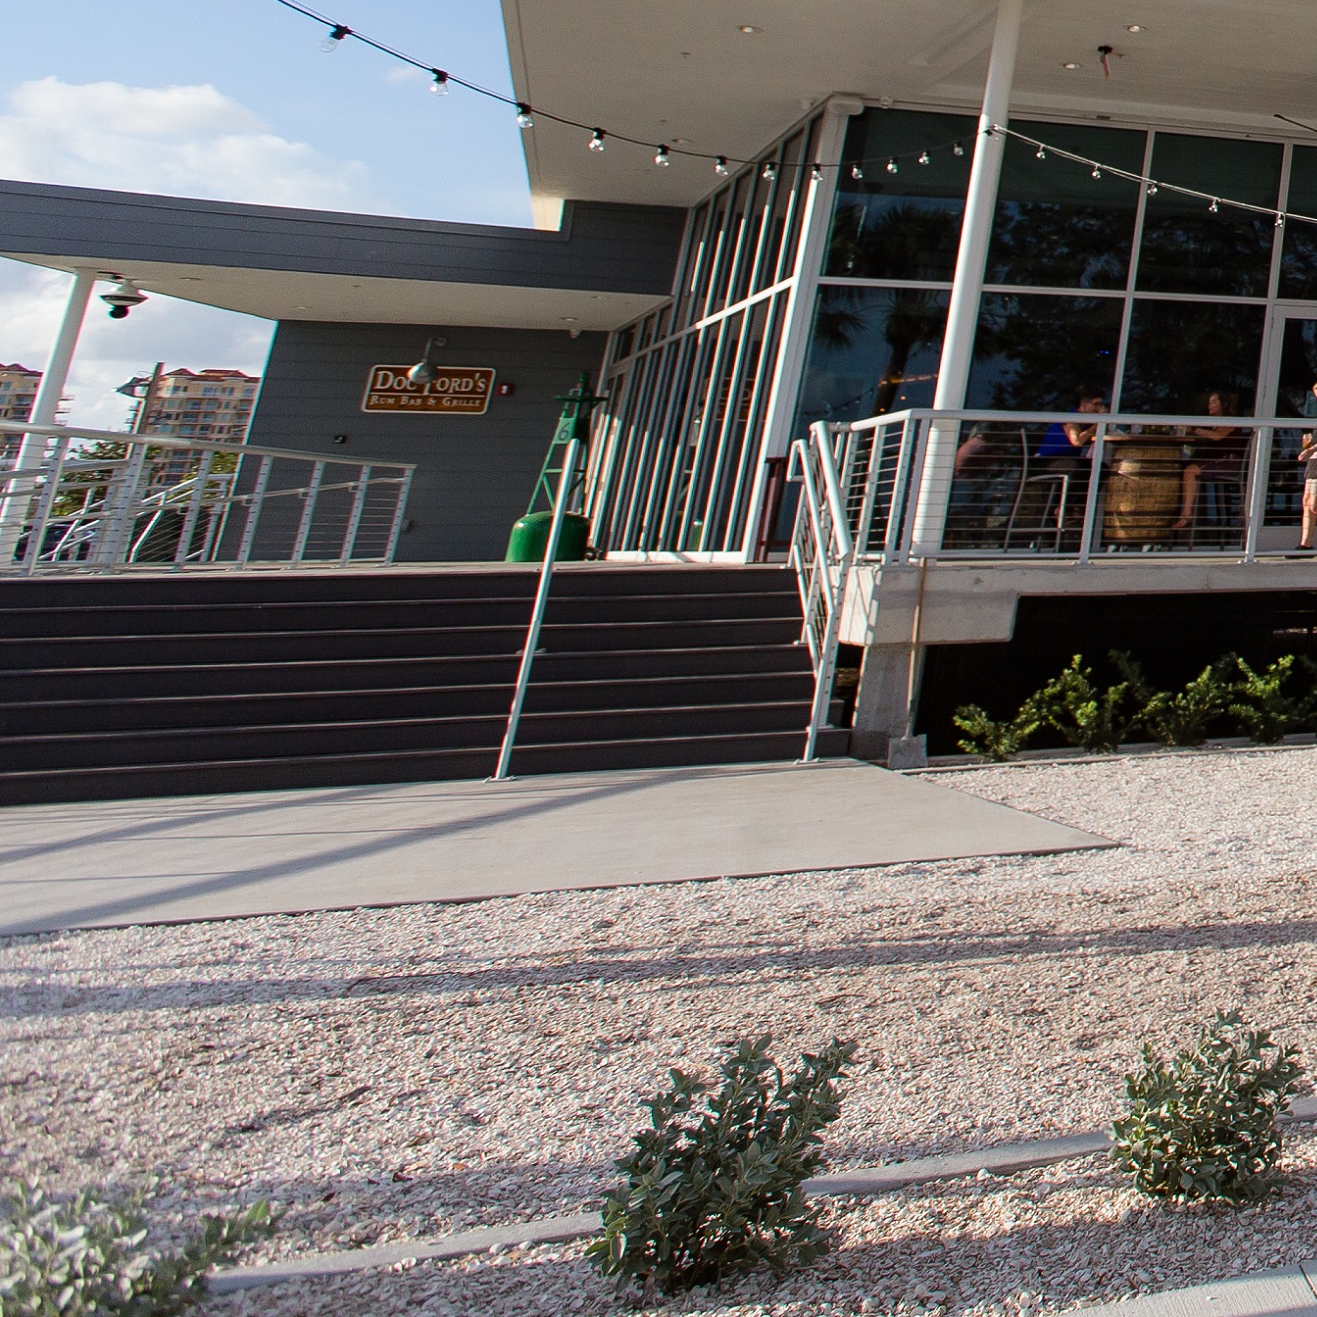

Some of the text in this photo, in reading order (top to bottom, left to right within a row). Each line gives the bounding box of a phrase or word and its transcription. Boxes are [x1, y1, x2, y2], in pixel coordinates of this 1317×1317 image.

[369, 395, 396, 405] RUM
[400, 395, 423, 406] BAR
[427, 397, 437, 407] &
[558, 422, 570, 441] 6
